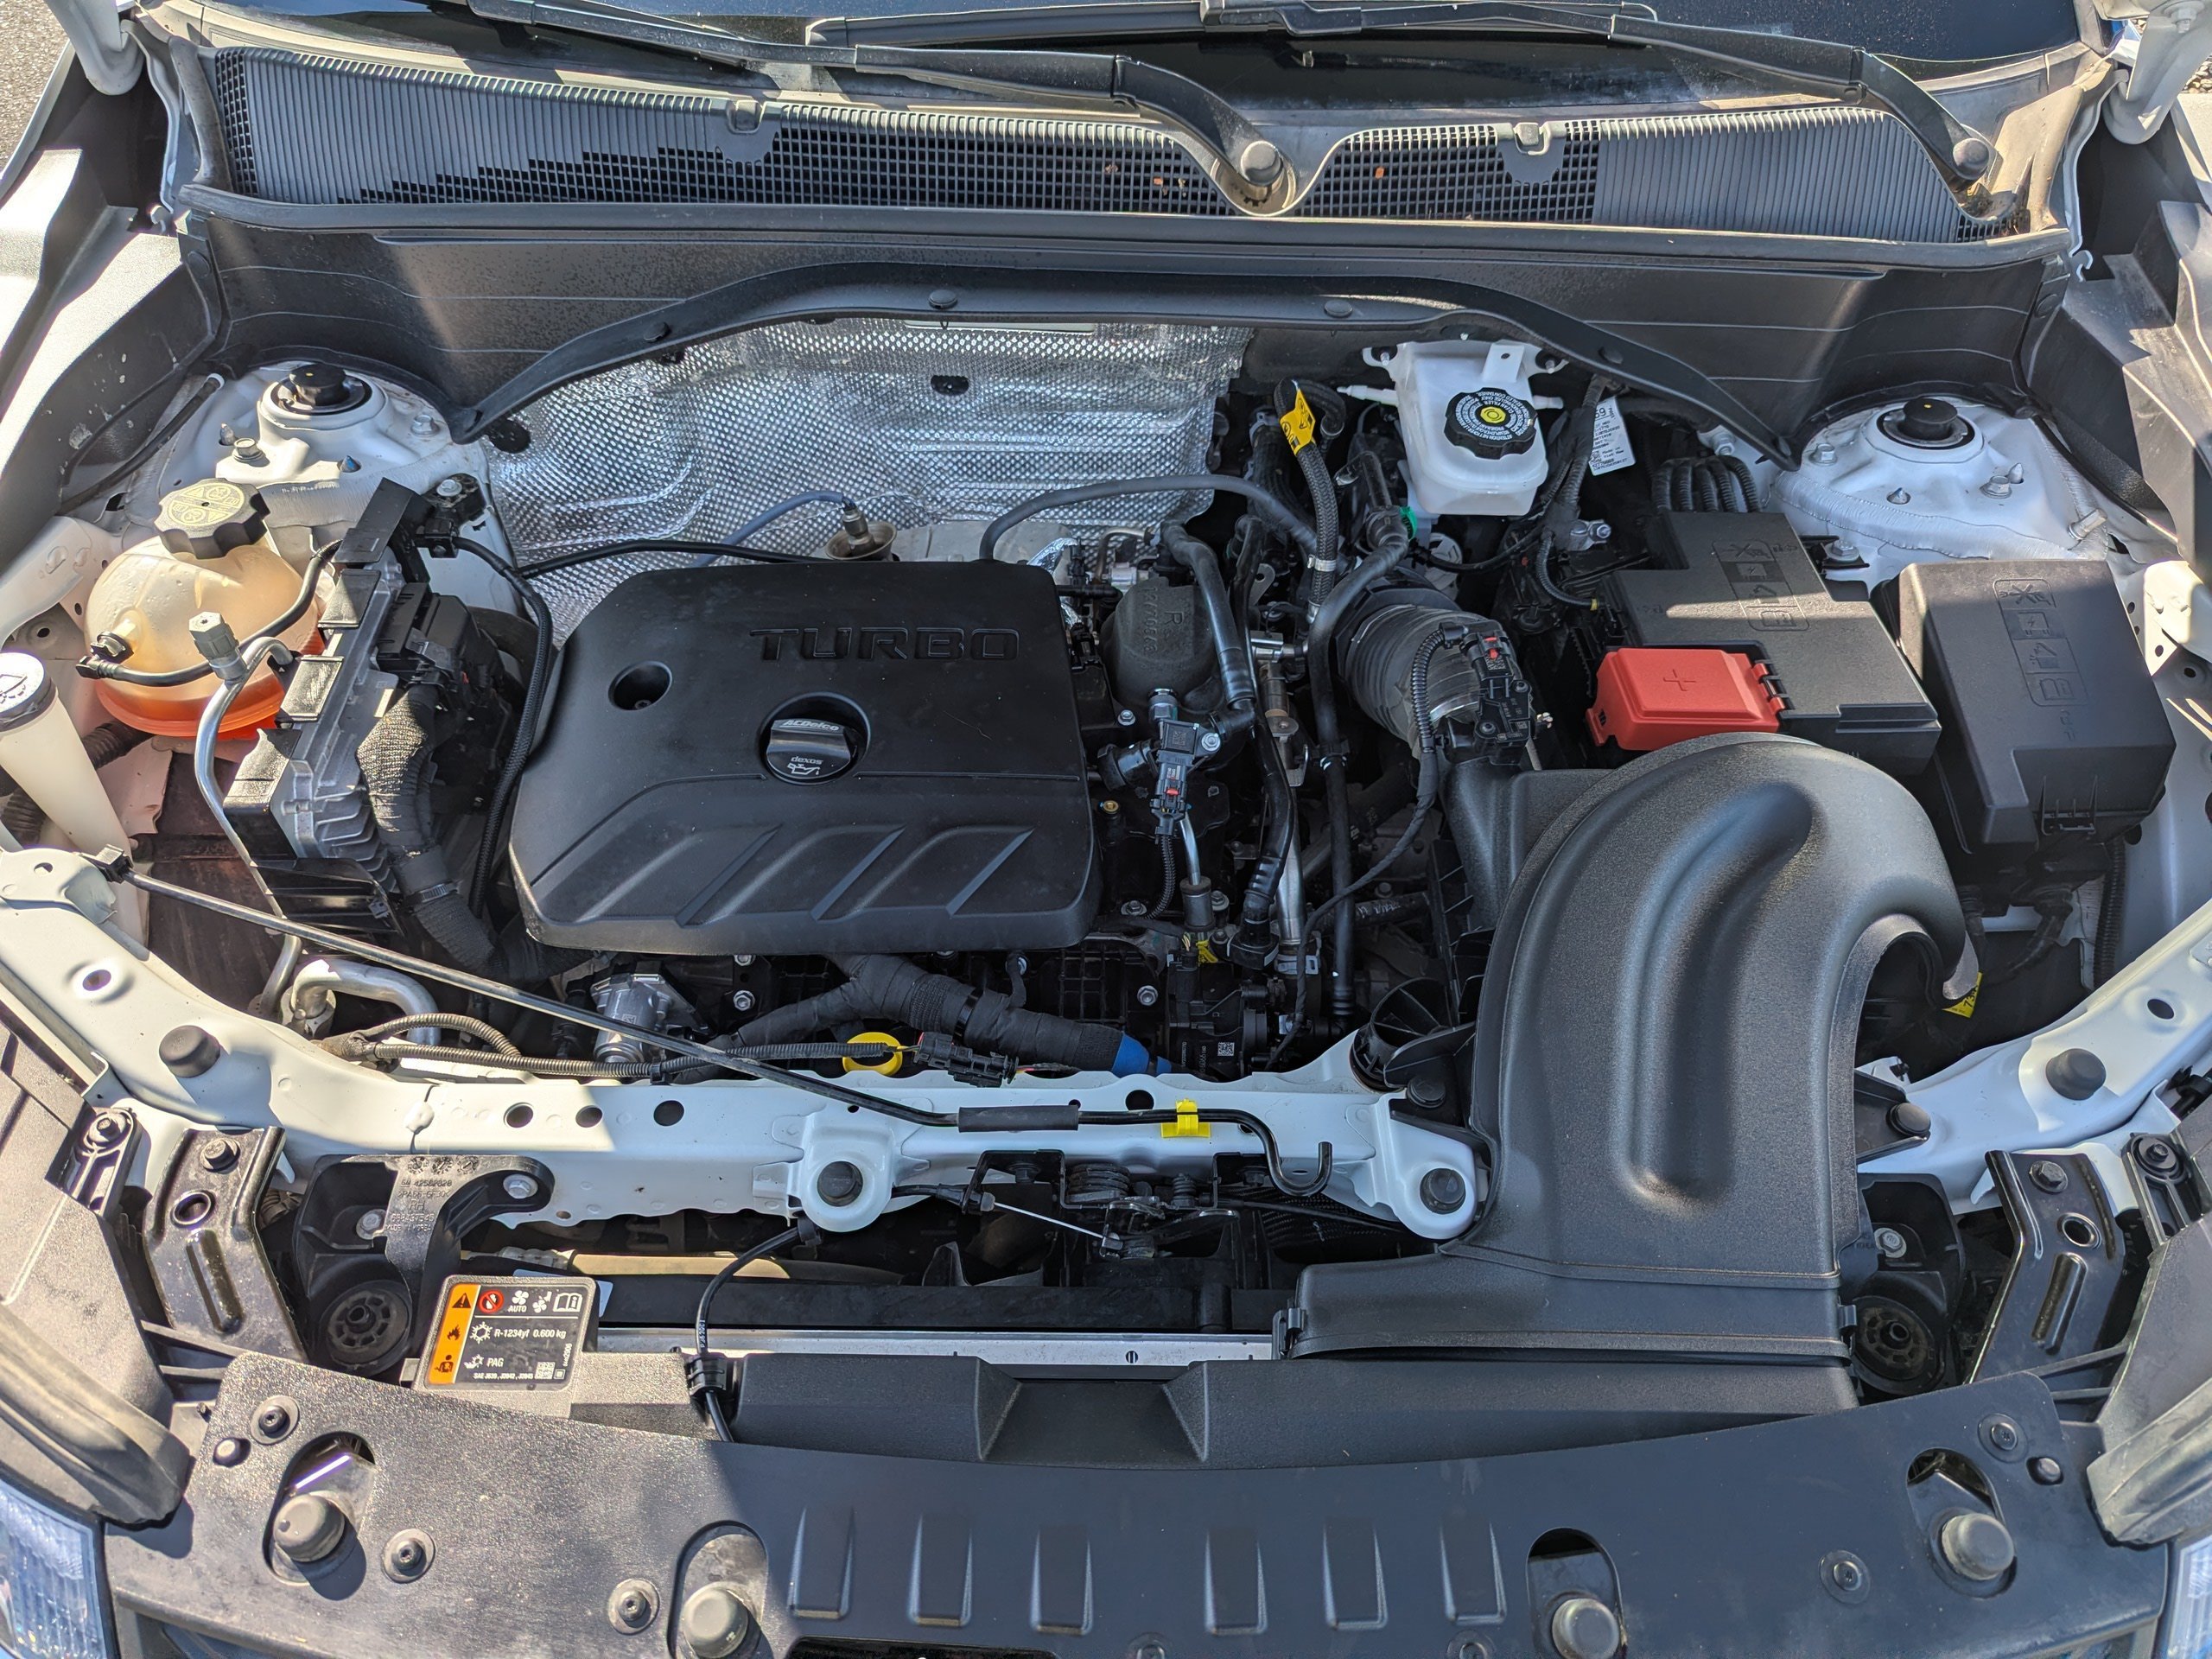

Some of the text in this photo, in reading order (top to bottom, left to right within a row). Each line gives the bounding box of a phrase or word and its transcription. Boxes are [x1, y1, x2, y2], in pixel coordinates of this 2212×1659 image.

[750, 627, 1020, 661] TURBO
[783, 719, 840, 731] ACDelco
[791, 756, 823, 765] dexos
[493, 1329, 567, 1339] R-1234yf 0.600 kg
[486, 1357, 505, 1368] PAG
